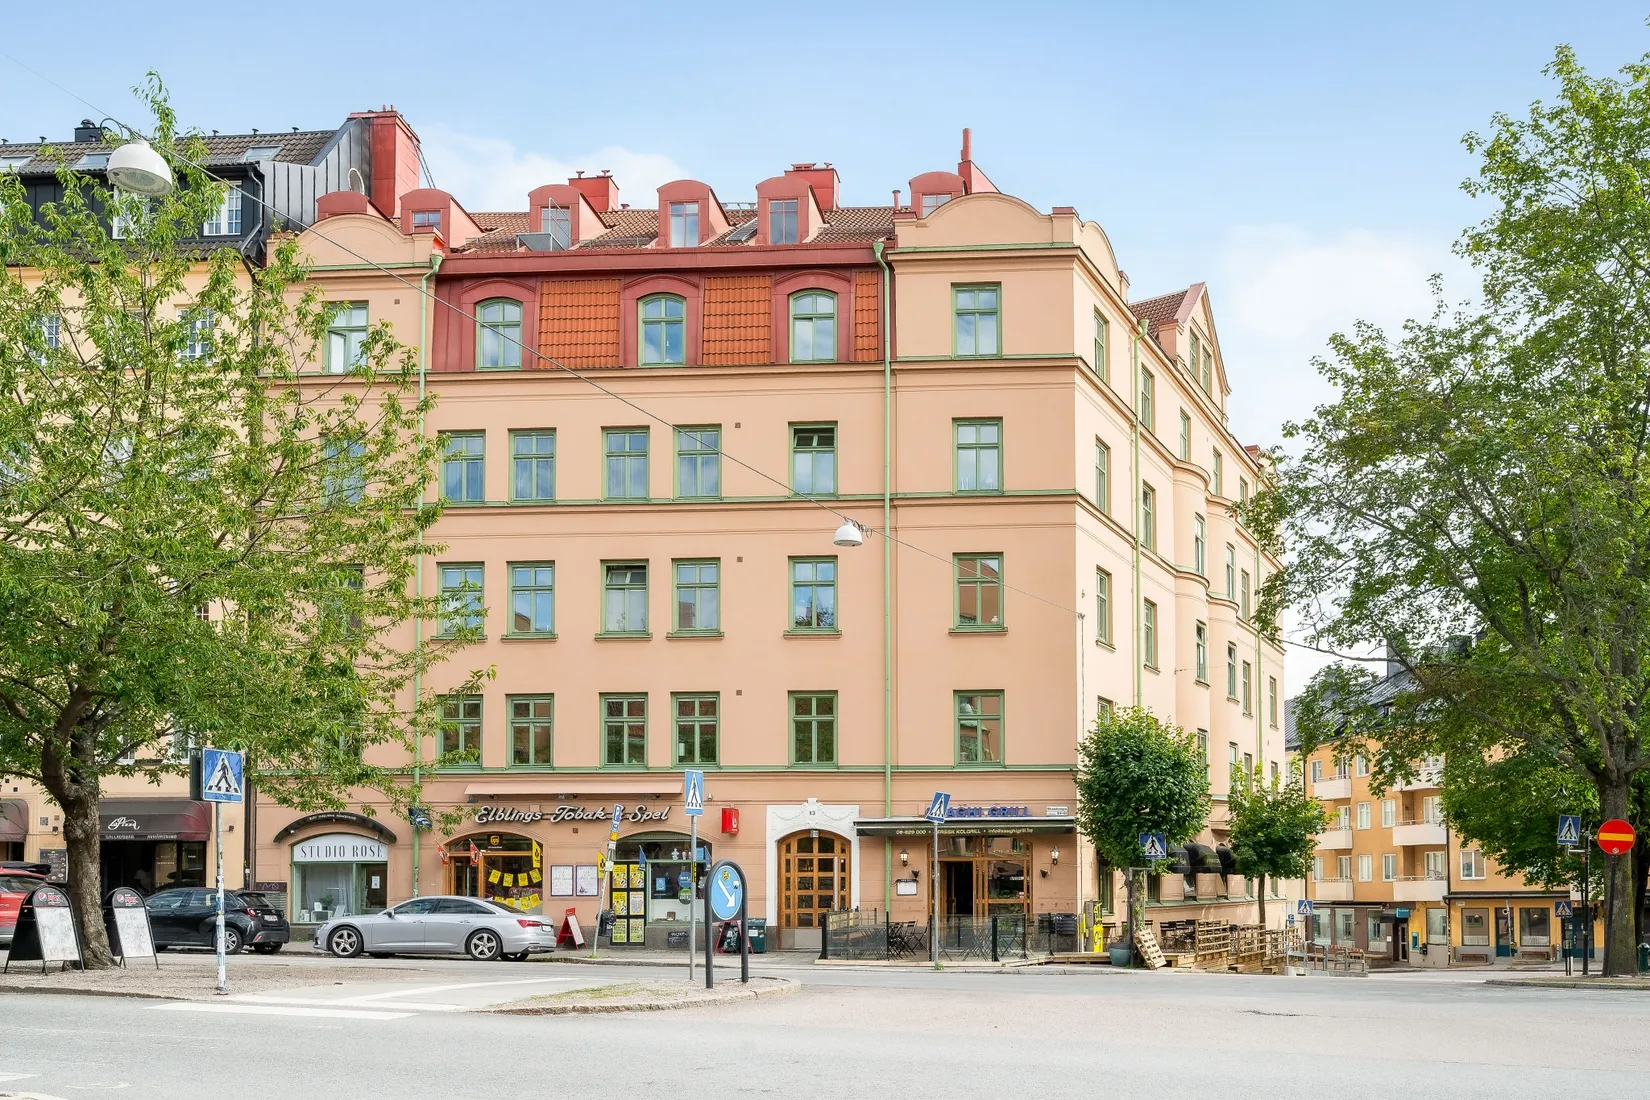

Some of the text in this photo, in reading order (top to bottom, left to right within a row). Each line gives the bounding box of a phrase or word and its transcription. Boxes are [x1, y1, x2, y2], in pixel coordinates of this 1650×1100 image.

[475, 804, 669, 823] Elblings Tobak Spel
[926, 806, 982, 818] AGHI
[988, 806, 1032, 818] GRILL
[300, 845, 346, 858] STUDIO
